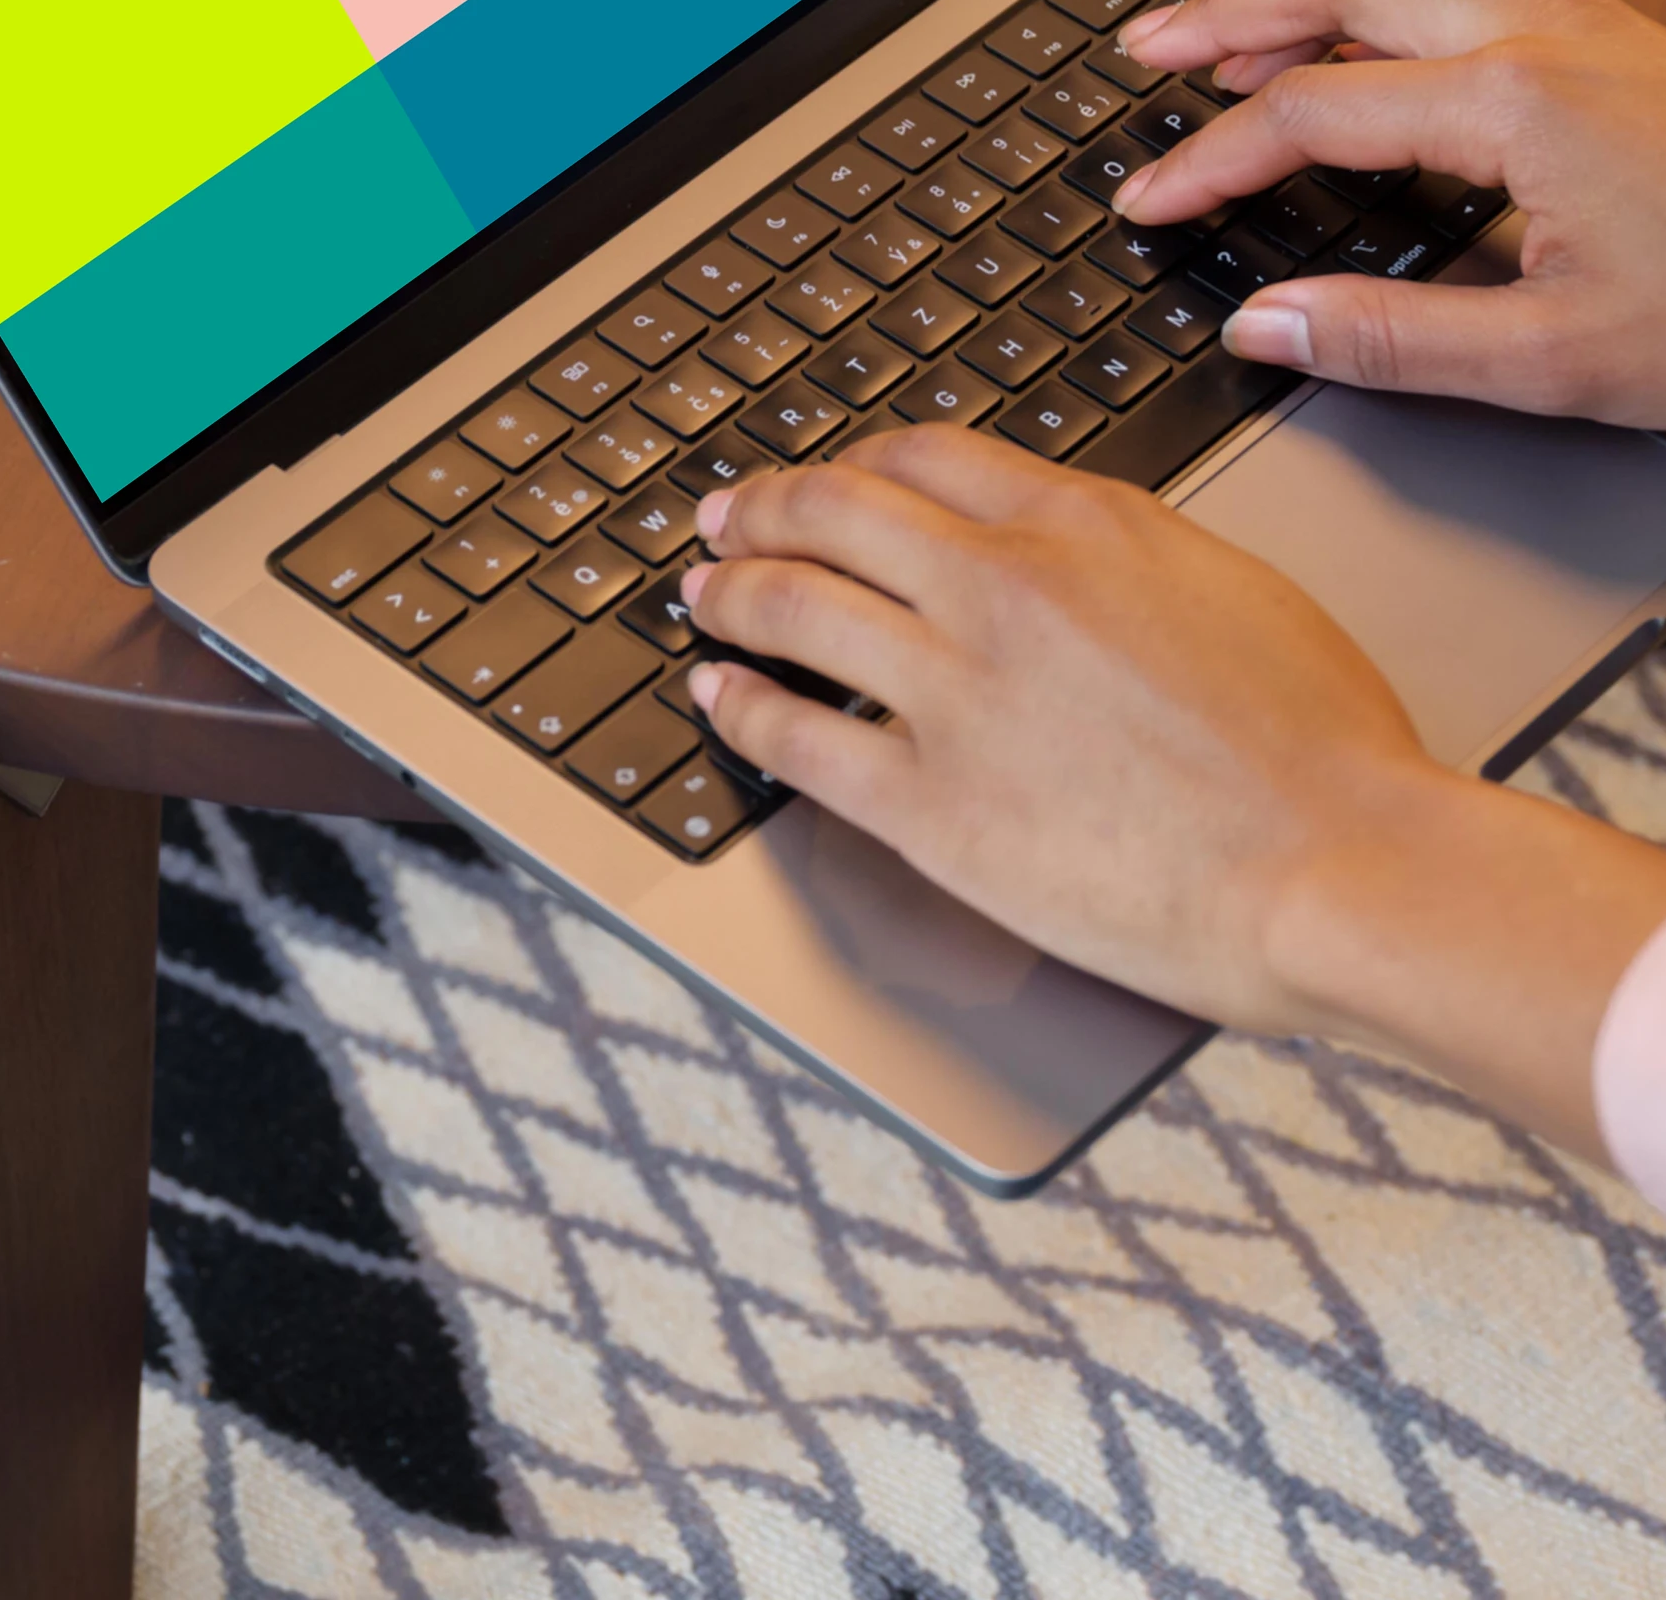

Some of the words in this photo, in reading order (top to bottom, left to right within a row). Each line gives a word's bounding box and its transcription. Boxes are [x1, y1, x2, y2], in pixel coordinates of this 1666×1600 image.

[1044, 42, 1062, 56] F10
[1055, 91, 1070, 102] 0
[1165, 114, 1181, 129] P
[992, 138, 1008, 149] 9
[1104, 162, 1125, 177] O
[929, 185, 945, 197] 8
[1043, 212, 1060, 224] I
[864, 234, 878, 245] 7
[1126, 241, 1150, 257] K
[975, 258, 999, 275] U
[1217, 252, 1237, 266] ?
[1387, 243, 1426, 276] option
[800, 282, 816, 295] 6
[1069, 291, 1085, 307] J
[912, 308, 936, 325] Z
[1165, 308, 1193, 328] M
[660, 331, 676, 343] F4
[734, 332, 750, 344] 5
[998, 339, 1024, 358] H
[845, 357, 867, 373] T
[1102, 358, 1128, 377] N
[668, 382, 682, 394] 4
[935, 391, 958, 407] G
[780, 408, 805, 427] R
[1039, 411, 1063, 428] B
[598, 434, 615, 447] 3
[712, 460, 736, 478] E
[529, 486, 547, 499] 2
[640, 510, 669, 532] W
[574, 566, 600, 584] Q
[665, 602, 690, 621] A
